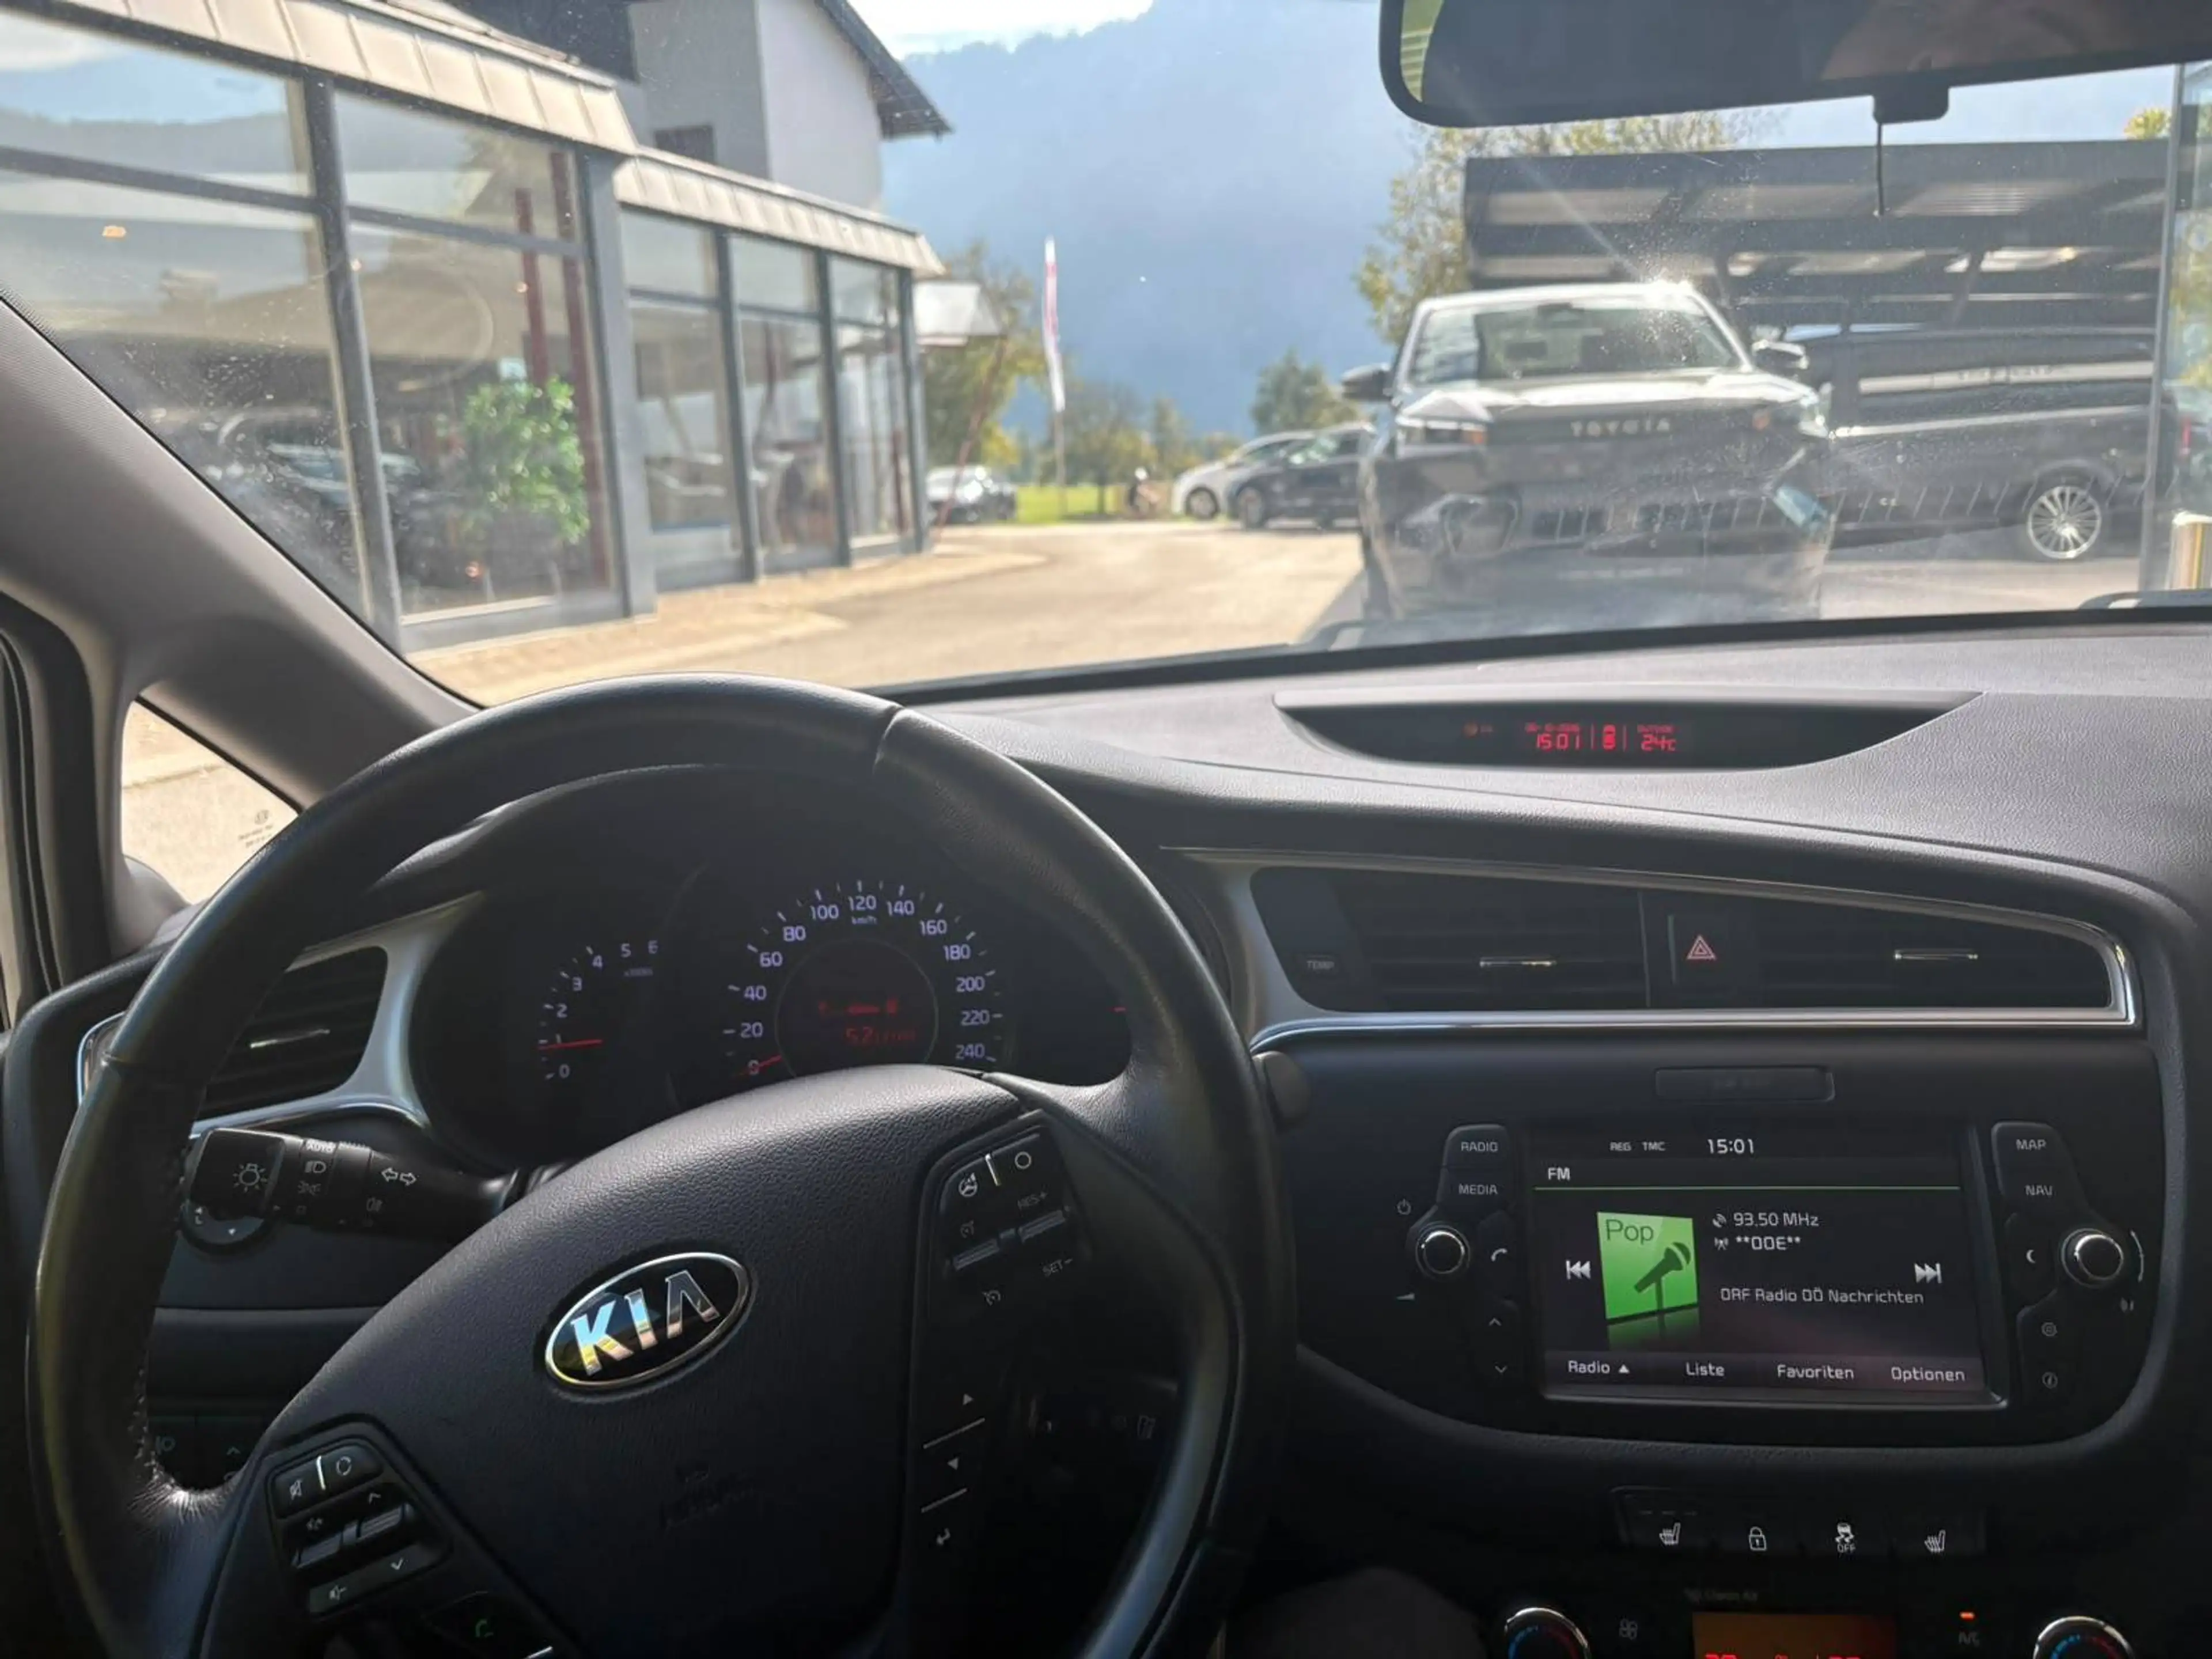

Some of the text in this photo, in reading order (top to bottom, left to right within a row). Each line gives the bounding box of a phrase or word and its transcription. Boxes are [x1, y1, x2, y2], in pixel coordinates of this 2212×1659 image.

[849, 895, 877, 911] 120
[887, 900, 915, 916] 140
[809, 905, 839, 920] 100
[782, 926, 806, 942] 80
[920, 919, 948, 935] 160
[620, 943, 632, 957] 5
[647, 940, 658, 954] 6
[944, 944, 971, 961] 180
[592, 955, 603, 968] 4
[759, 950, 783, 968] 60
[573, 977, 582, 991] 3
[956, 976, 986, 993] 200
[744, 985, 767, 1001] 40
[556, 1003, 567, 1018] 2
[961, 1009, 990, 1027] 220
[740, 1022, 764, 1038] 20
[955, 1043, 986, 1060] 240
[559, 1065, 570, 1078] 0
[1460, 1141, 1498, 1152] RADIO
[1610, 1142, 1665, 1152] REG TMC
[1707, 1138, 1755, 1154] 15:01
[2016, 1139, 2047, 1150] MAP
[1548, 1167, 1570, 1180] FM
[1458, 1184, 1498, 1195] MEDIA
[2025, 1184, 2052, 1196] NAV
[1733, 1212, 1820, 1228] 93.50 MHz
[1605, 1218, 1654, 1245] Pop
[1720, 1288, 1751, 1302] ORF
[1755, 1289, 1797, 1303] Radio
[1828, 1289, 1925, 1304] Nachrichten
[569, 1269, 720, 1376] KIA
[1567, 1359, 1611, 1374] Radio
[1685, 1363, 1725, 1377] Liste
[1777, 1365, 1855, 1380] Favoriten
[1891, 1367, 1966, 1382] Optionen
